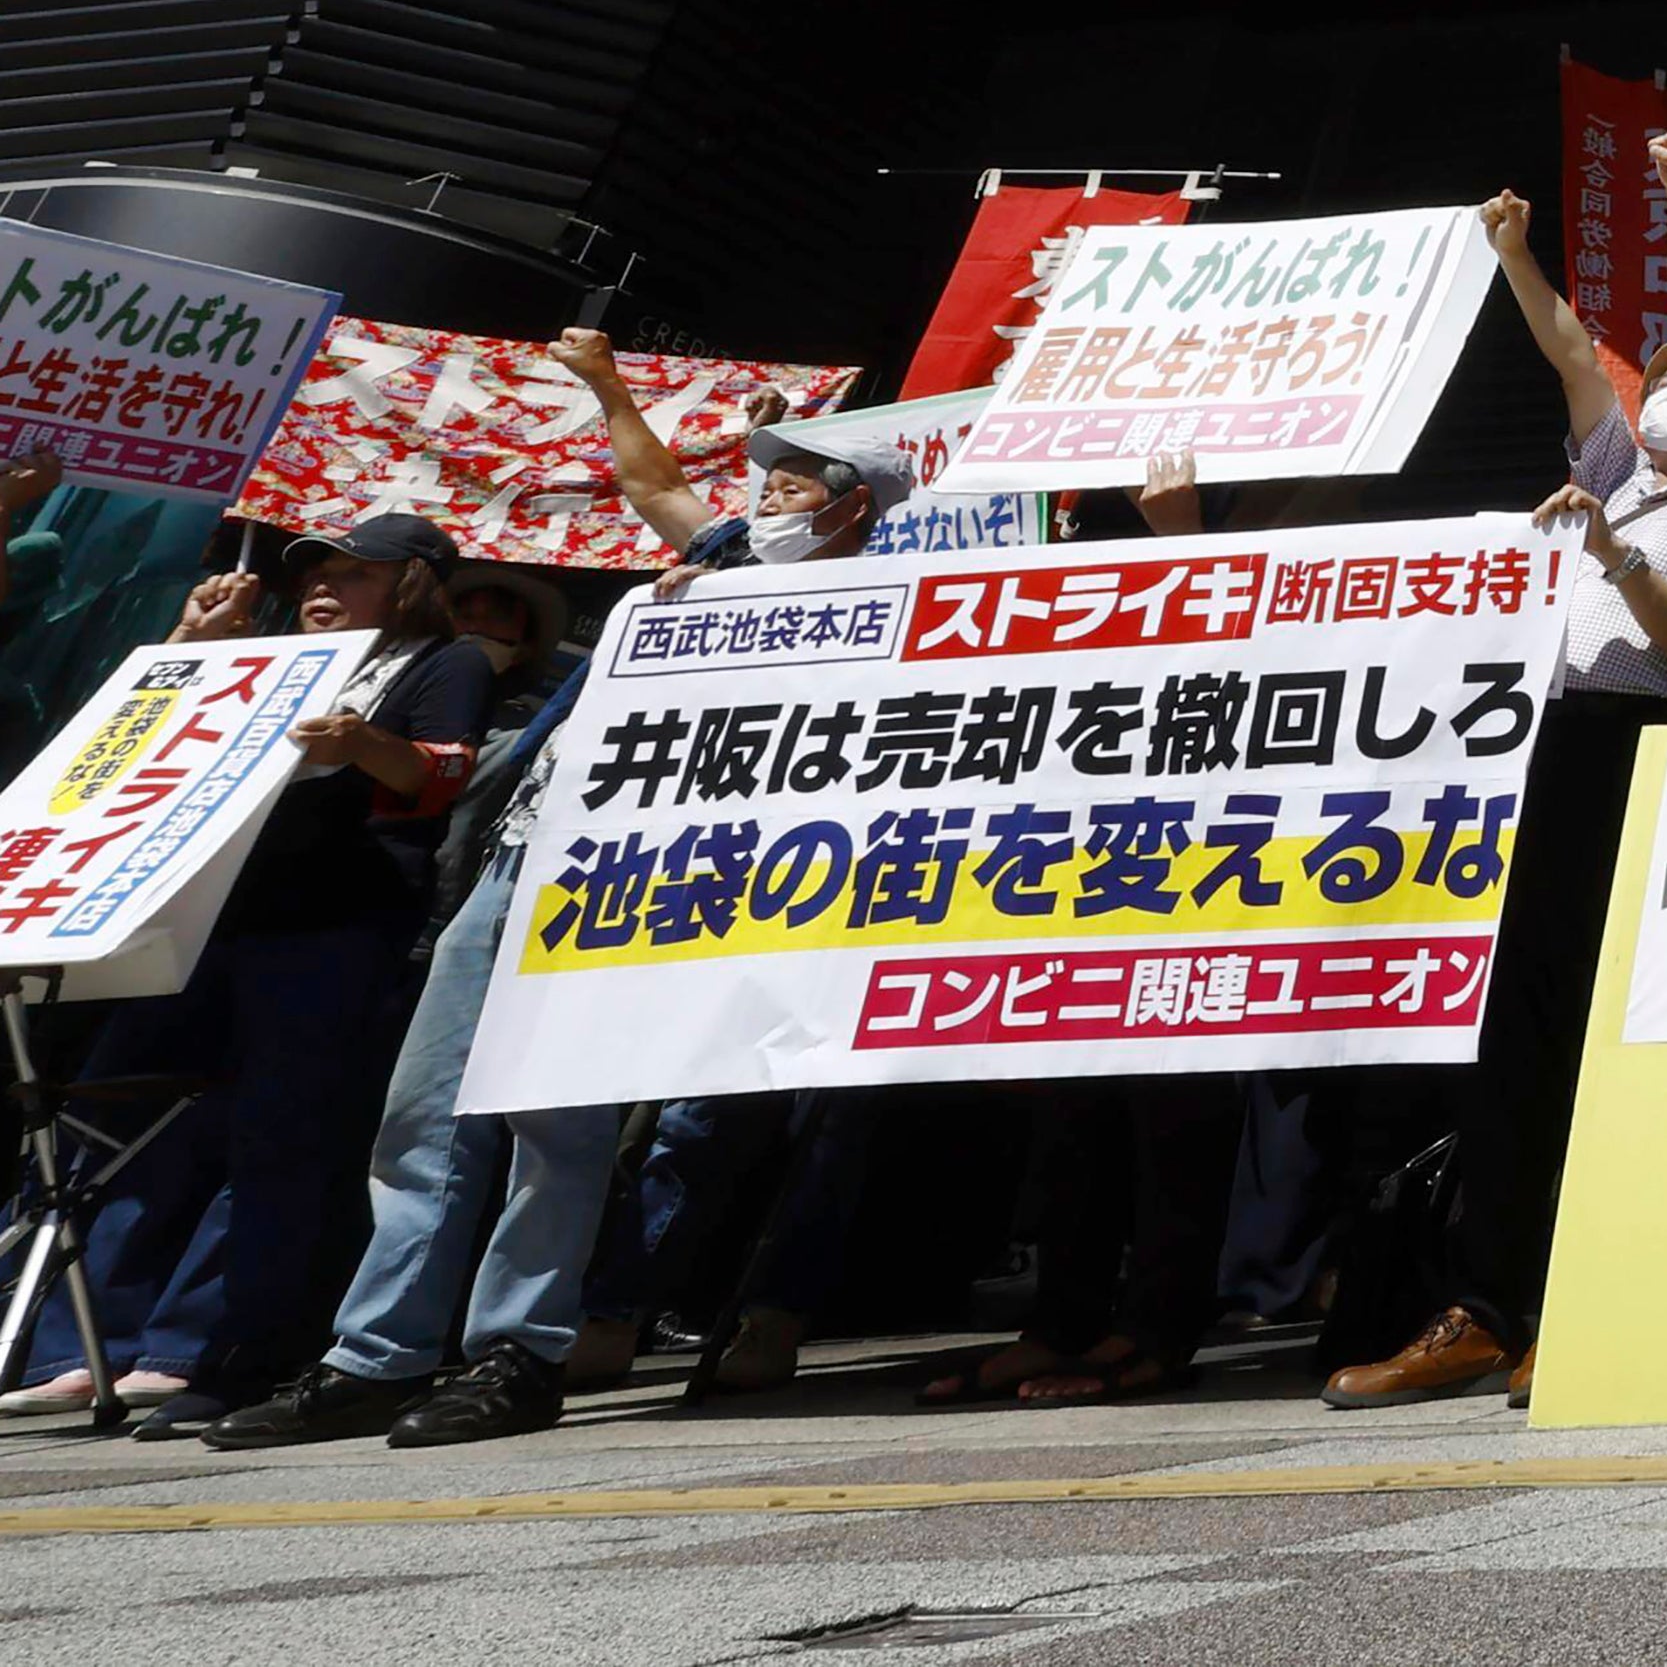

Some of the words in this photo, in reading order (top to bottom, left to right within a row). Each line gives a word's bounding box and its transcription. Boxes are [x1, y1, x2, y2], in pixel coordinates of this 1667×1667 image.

[1060, 225, 1433, 314] ストがんばれ！
[1007, 312, 1389, 405] 雇用と生活守ろう！
[971, 401, 1354, 460] コンビニ関連ユニオン
[628, 599, 893, 662] 西武池袋本店
[917, 562, 1255, 651] ストライキ
[1266, 548, 1562, 624] 断固支持！
[581, 662, 1535, 811] 井阪は売却を撤回しろ
[0, 656, 277, 933] ストライキ
[540, 784, 1518, 952] 池袋の街を変えるな
[866, 947, 1487, 1032] コンビニ関連ユニオン
